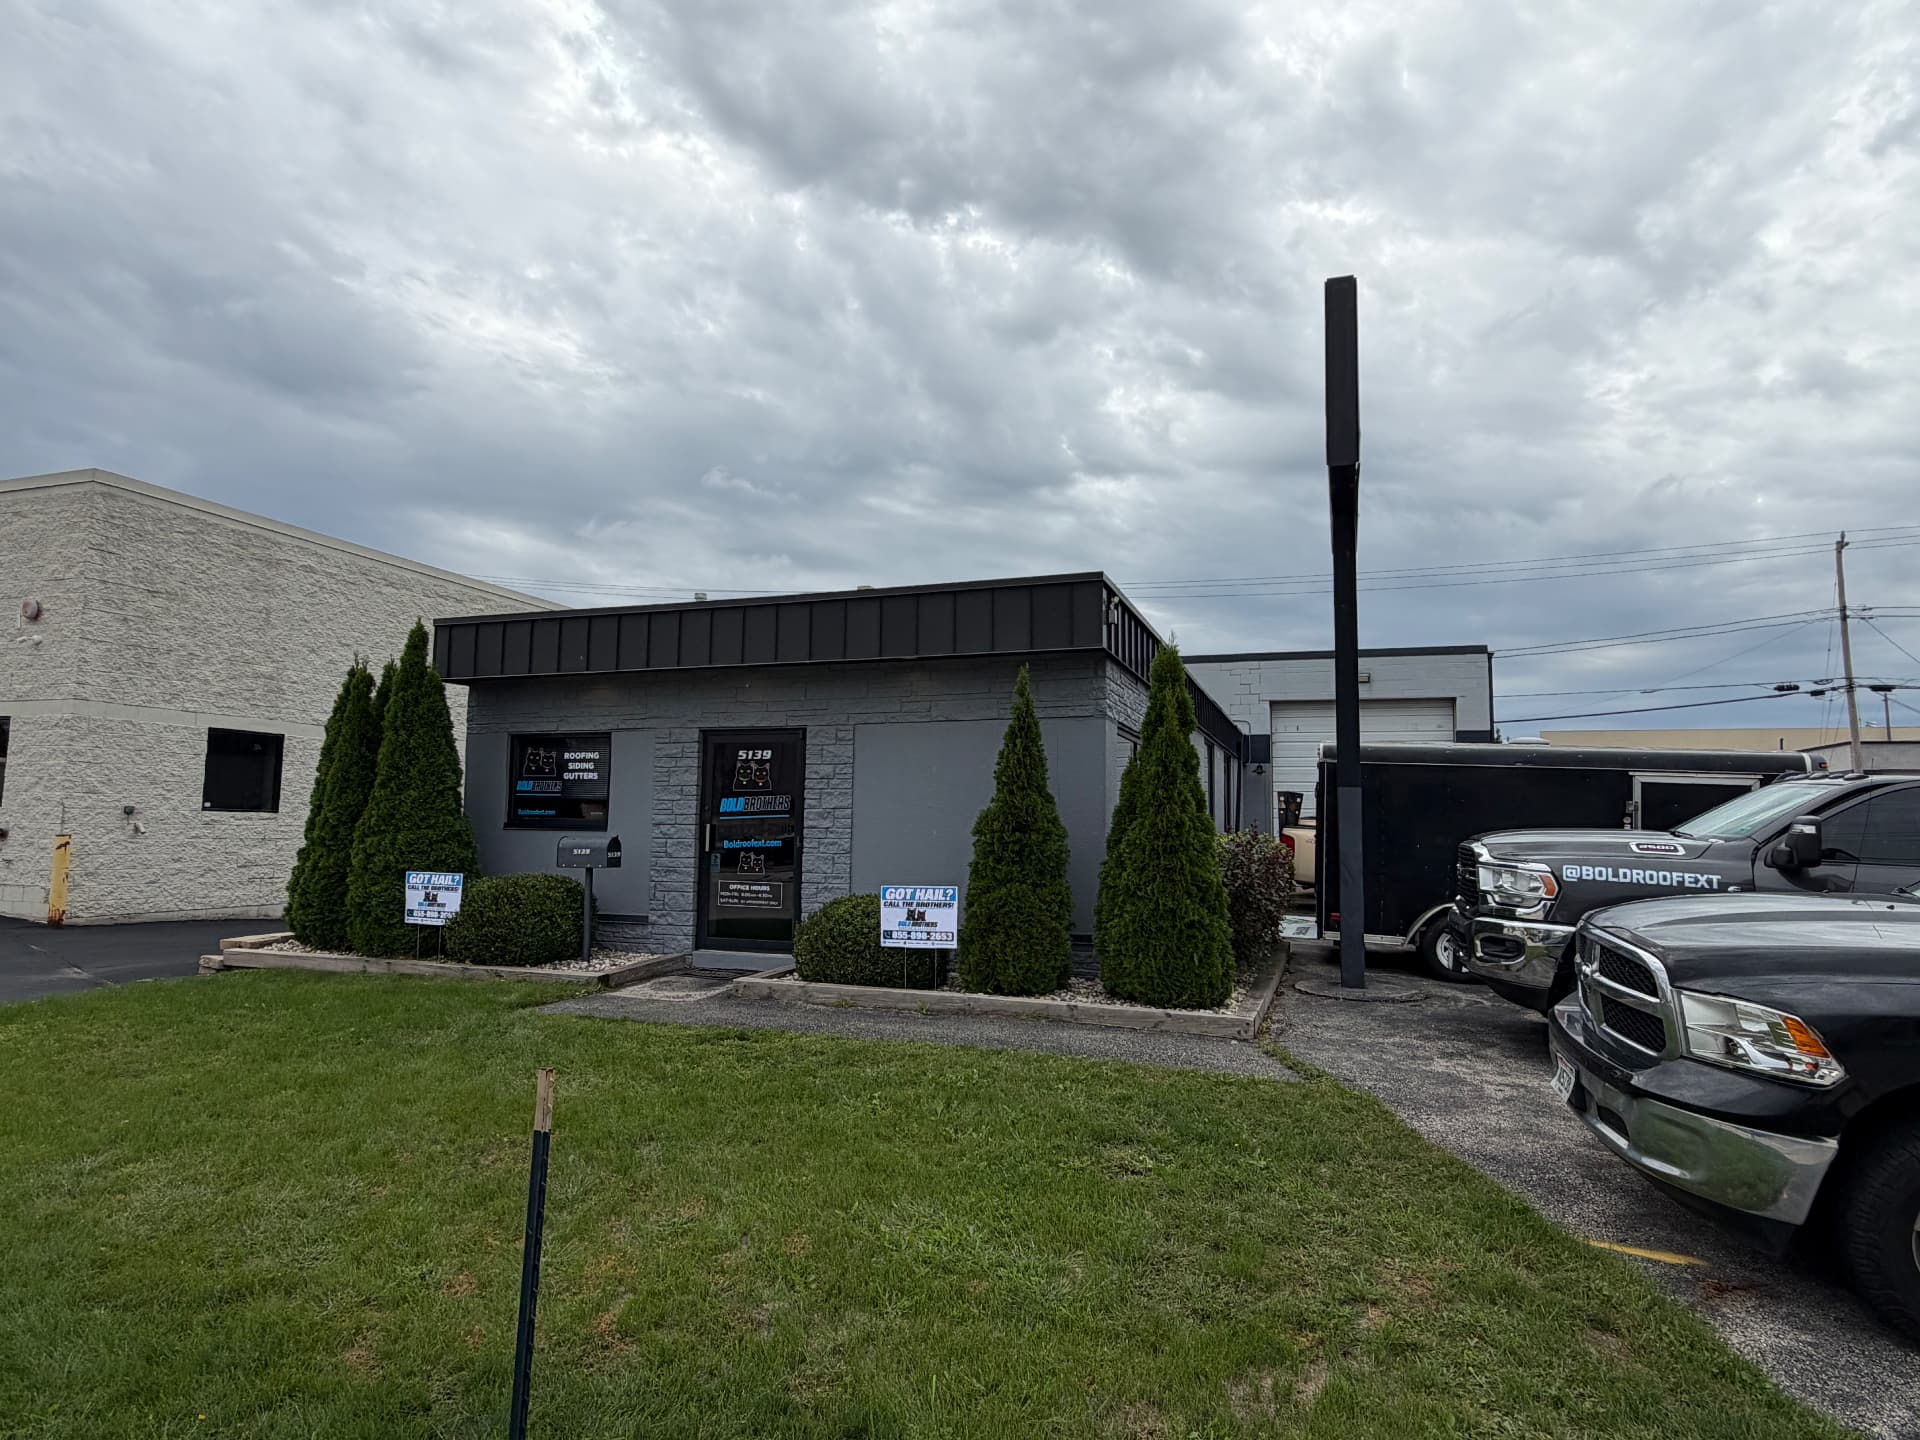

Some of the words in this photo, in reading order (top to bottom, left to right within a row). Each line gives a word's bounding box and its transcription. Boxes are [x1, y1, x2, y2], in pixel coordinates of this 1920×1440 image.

[738, 750, 772, 760] 5139
[568, 762, 594, 770] SIDING
[563, 772, 598, 780] GUTTERS
[409, 874, 430, 884] GOT
[431, 875, 460, 885] HAIL?
[1562, 865, 1721, 889] @BOLDROOFEXT
[885, 888, 914, 900] GOT
[915, 889, 953, 901] HAIL?
